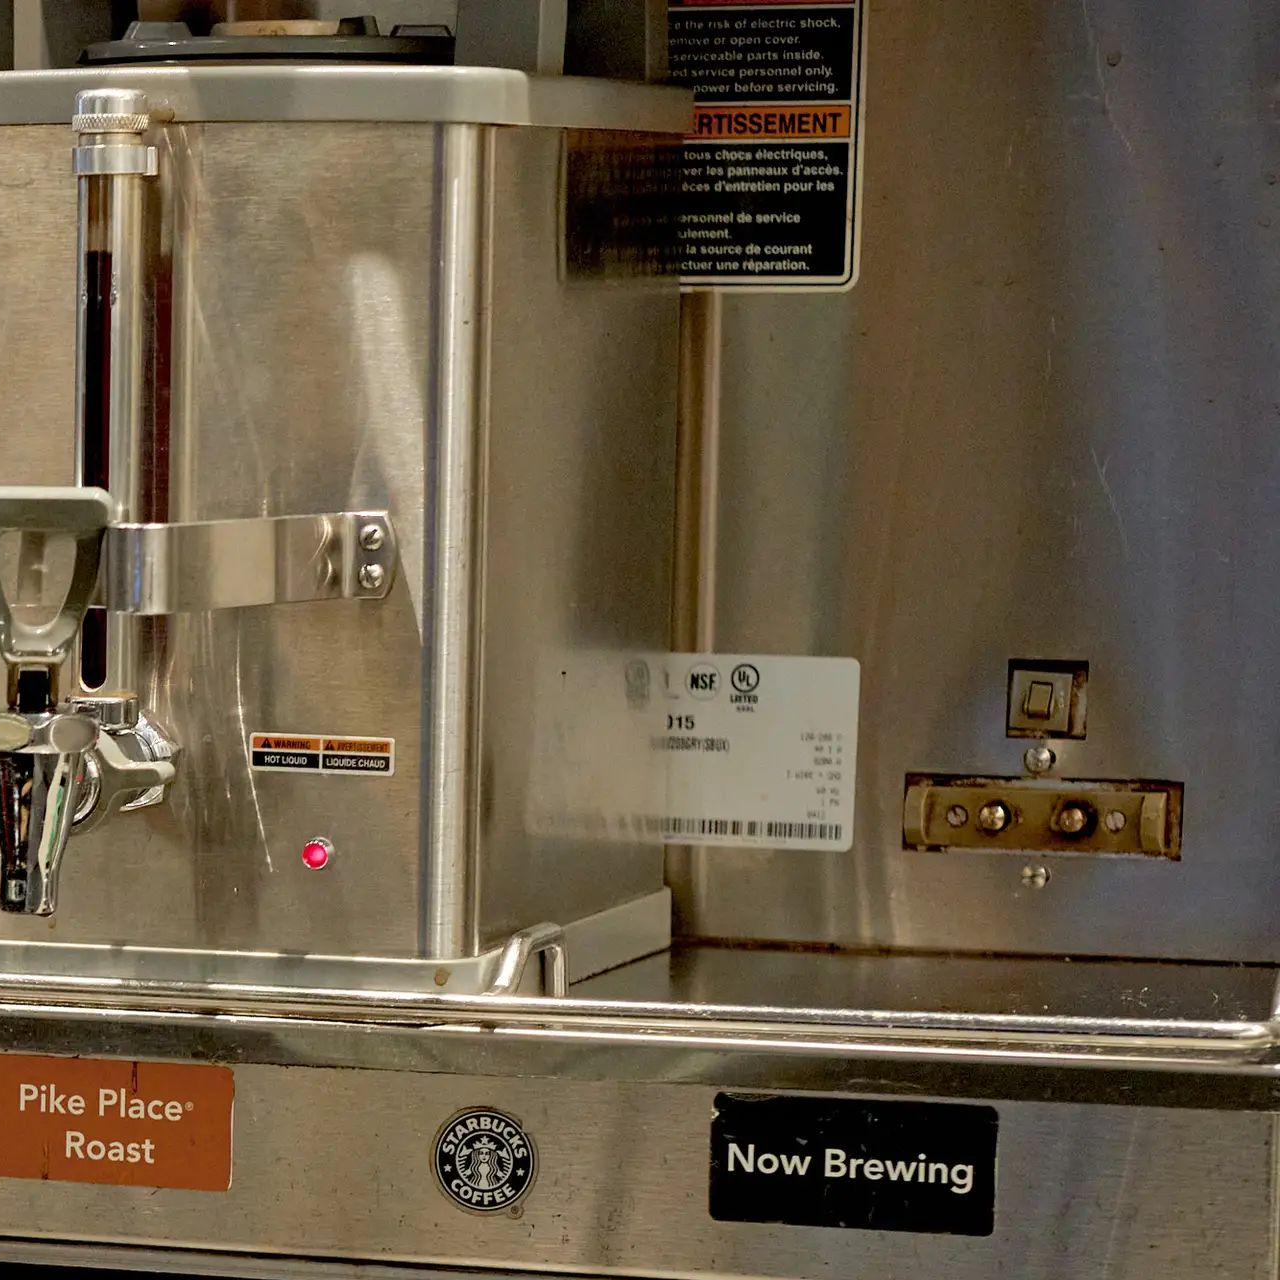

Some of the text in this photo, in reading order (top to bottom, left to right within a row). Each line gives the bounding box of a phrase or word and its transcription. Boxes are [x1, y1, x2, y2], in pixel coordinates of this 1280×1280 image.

[685, 19, 704, 30] the
[708, 19, 731, 29] risk
[734, 18, 748, 28] of
[750, 18, 796, 28] electric
[668, 37, 710, 46] emove
[713, 37, 726, 45] or
[730, 36, 761, 47] open
[668, 49, 824, 63] -serviceable parts inside.
[691, 67, 735, 77] service
[739, 65, 802, 80] personnel
[734, 82, 773, 92] before
[777, 80, 839, 94] servicing.
[694, 112, 842, 134] RTISSEMENT
[684, 151, 711, 161] tous
[715, 150, 752, 161] chocs
[706, 165, 724, 176] les
[727, 167, 788, 179] panneaux
[681, 180, 835, 194] èces d'entretien pour les
[679, 212, 801, 223] ersonnel de service
[686, 244, 813, 255] la source de courant
[681, 260, 712, 270] ctuer
[716, 261, 740, 270] une
[690, 673, 717, 690] NSF
[274, 739, 311, 750] WARNING
[264, 755, 308, 765] HOT LIQUID
[326, 758, 386, 769] LIQUIDE CHAUD
[19, 1084, 85, 1116] Pike
[442, 1116, 528, 1159] STARBUCKS
[64, 1130, 156, 1165] Roast
[727, 1143, 974, 1194] Now Brewing
[451, 1179, 516, 1205] COFFEE
